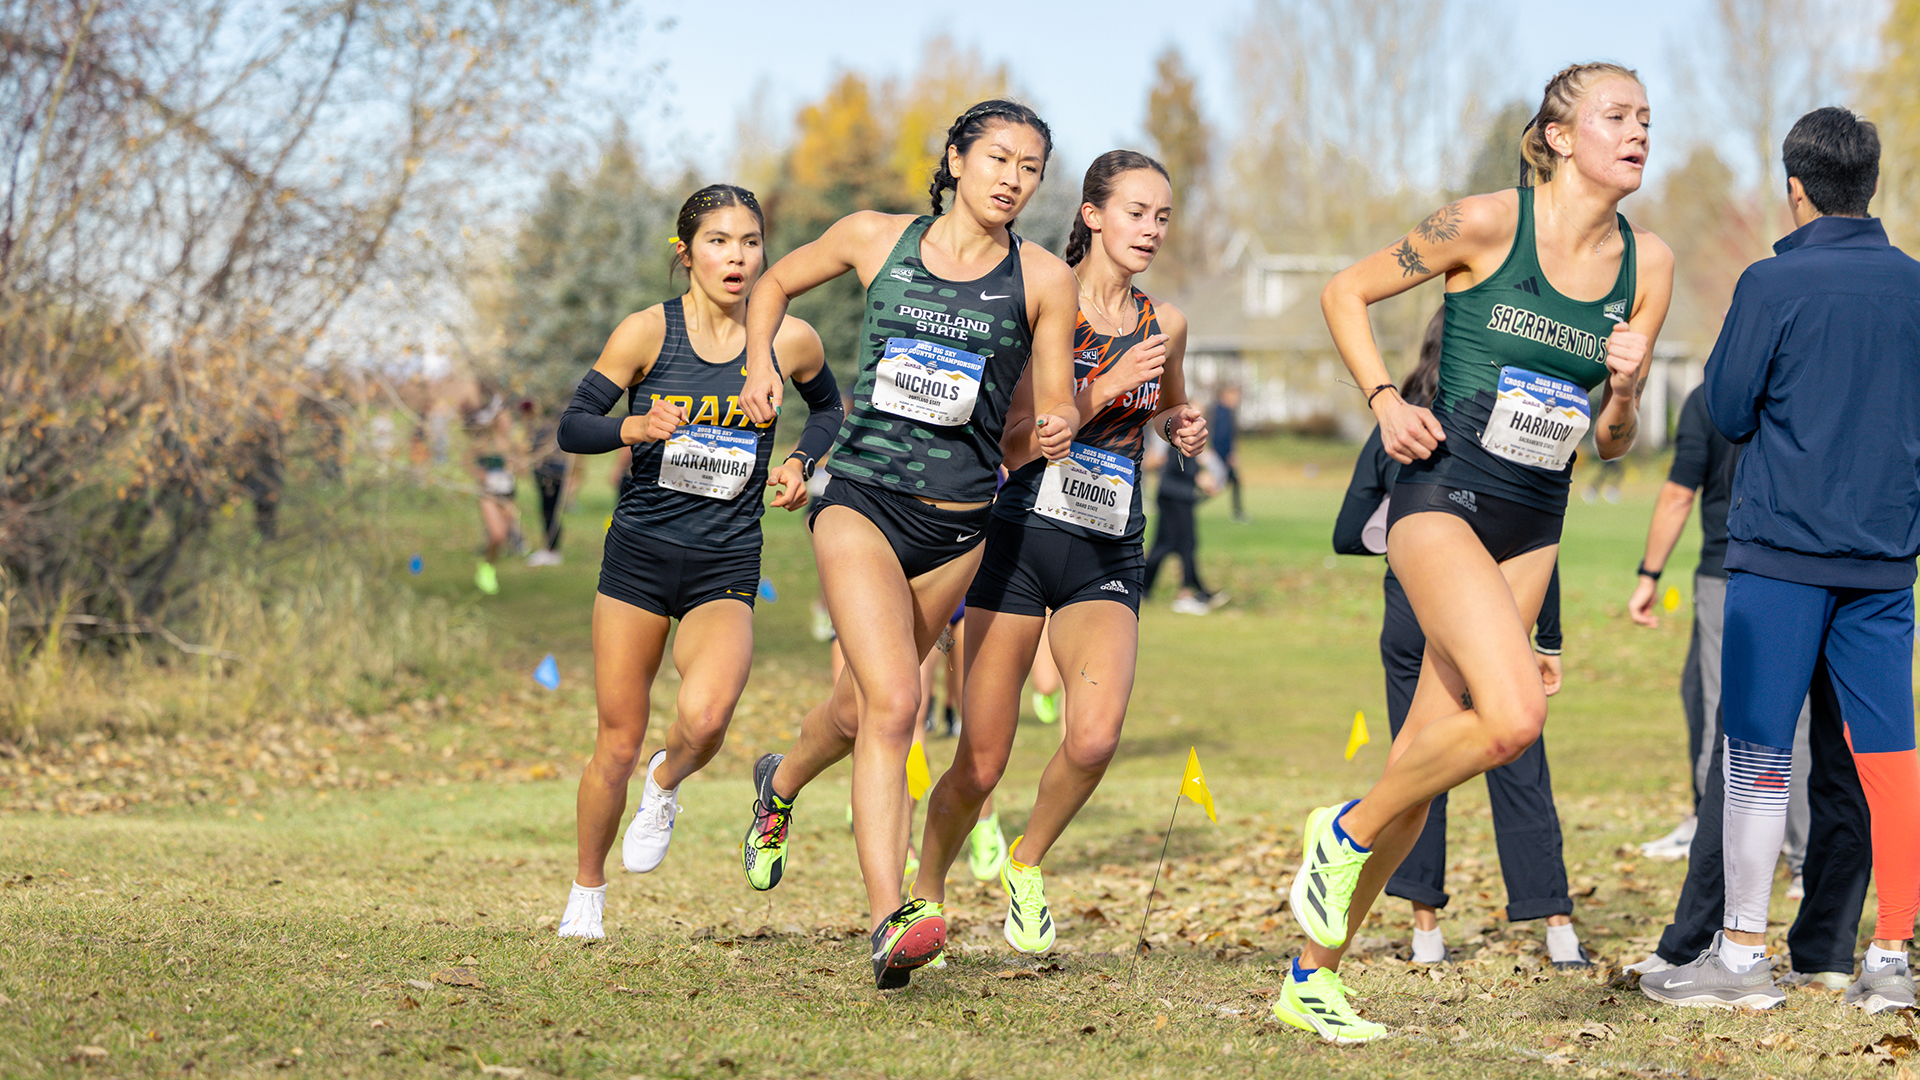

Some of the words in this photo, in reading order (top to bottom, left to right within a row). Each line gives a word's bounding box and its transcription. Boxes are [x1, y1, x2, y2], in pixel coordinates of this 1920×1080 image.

[899, 305, 990, 333] PORTLAND
[916, 320, 968, 340] STATE
[1487, 304, 1596, 359] SACRAMENTO
[908, 348, 936, 360] COUNTRY
[936, 356, 981, 371] CHAMPIONSHIP
[944, 349, 957, 357] SKY
[895, 372, 960, 401] NICHOLS
[1504, 377, 1526, 388] CROSS
[1526, 383, 1556, 396] COUNTRY
[1535, 377, 1551, 387] 2025
[1551, 381, 1562, 390] BIG
[1563, 384, 1574, 394] SKY
[1510, 411, 1573, 442] HARMON
[691, 431, 715, 440] COUNTRY
[716, 435, 754, 445] CHAMPIONSHIP
[670, 452, 748, 477] NAKAMURA
[1075, 453, 1100, 465] COUNTRY
[1083, 449, 1097, 457] 2025
[1106, 455, 1116, 463] SKY
[1061, 477, 1117, 507] LEMONS
[1448, 493, 1478, 513] adidas
[1100, 585, 1129, 594] adidas
